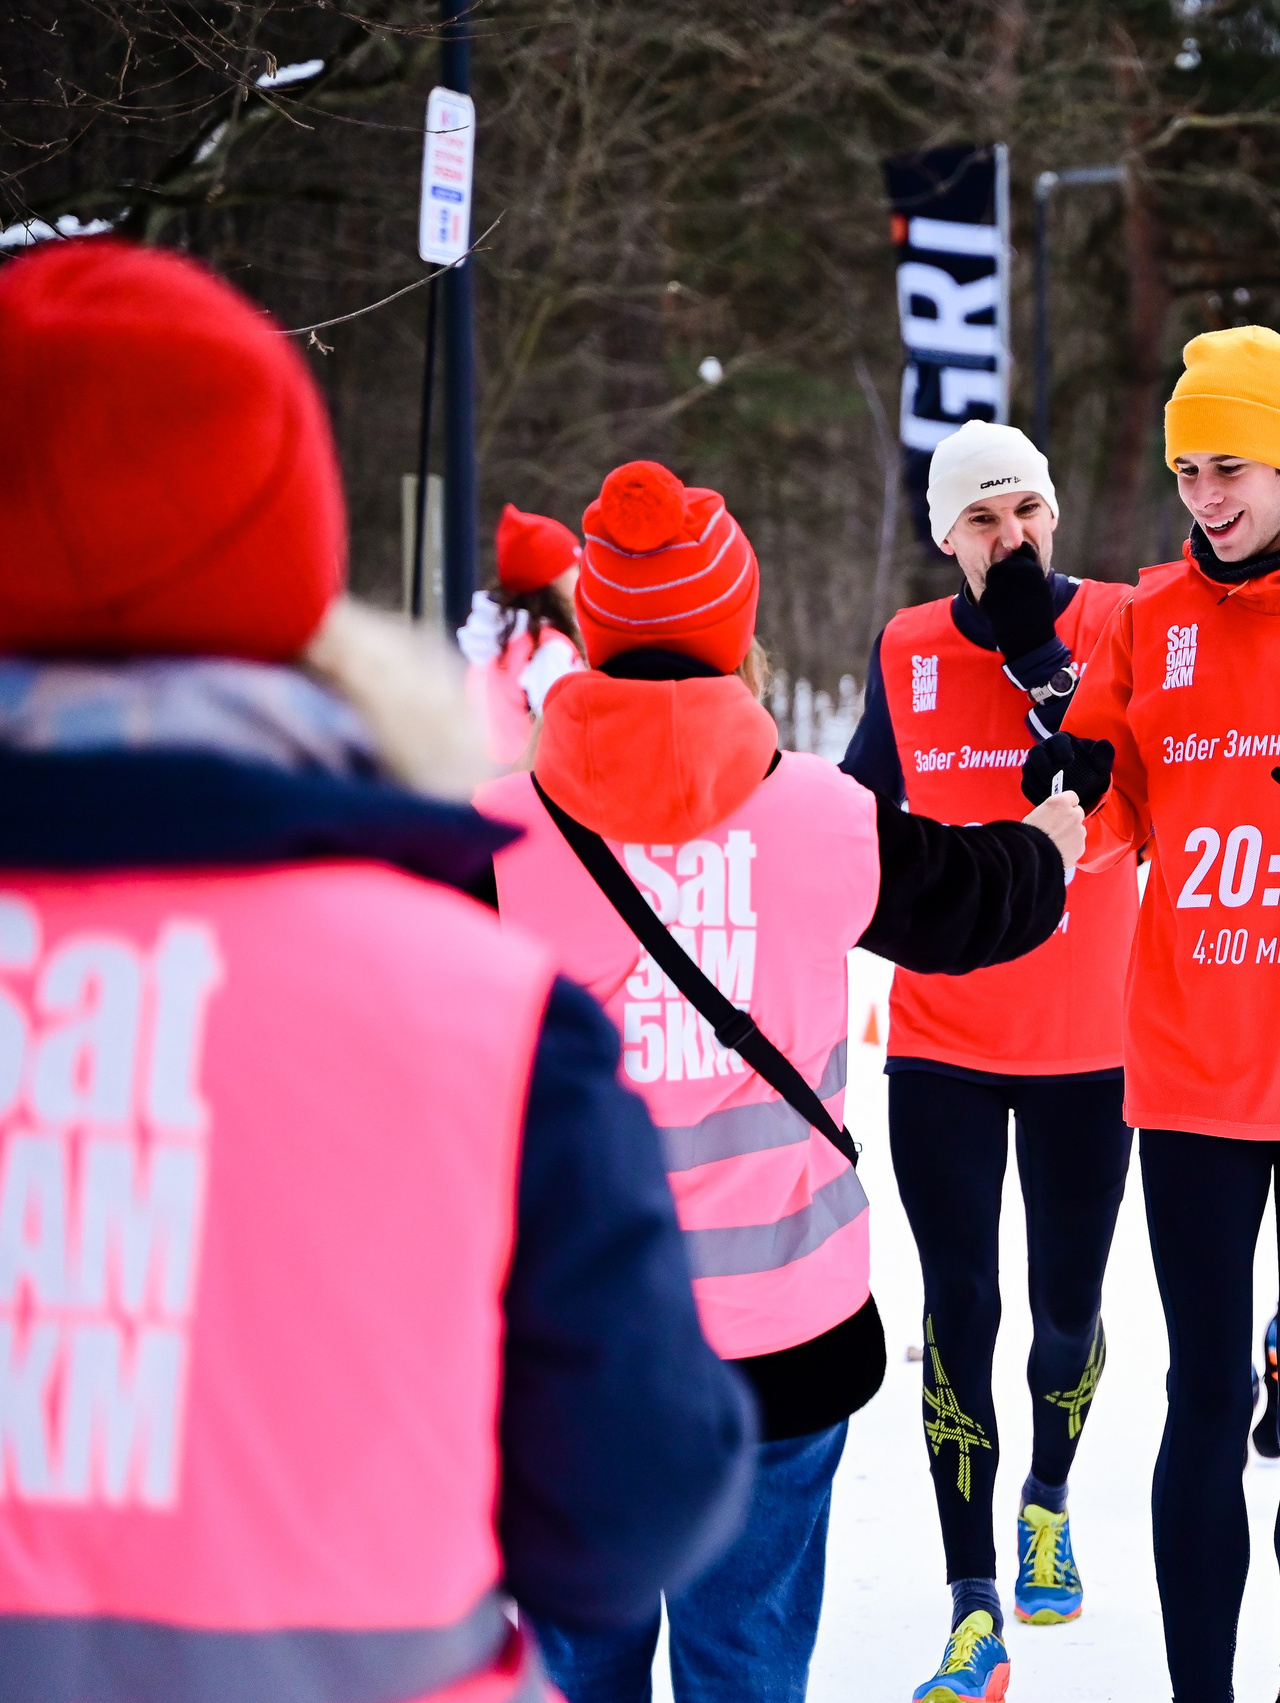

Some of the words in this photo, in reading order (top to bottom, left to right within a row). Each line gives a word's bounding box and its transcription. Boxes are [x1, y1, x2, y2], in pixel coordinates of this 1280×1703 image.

[980, 477, 1013, 489] CRAFT
[1167, 623, 1198, 651] Sat
[911, 654, 938, 678] Sat
[1166, 647, 1197, 671] 9AM
[912, 676, 938, 695] 9AM
[1162, 666, 1194, 690] 5KM
[914, 748, 956, 773] Забег
[958, 745, 1030, 769] Зимних
[1162, 733, 1220, 764] Забег
[623, 830, 757, 927] Sat
[1192, 928, 1249, 965] 4:00
